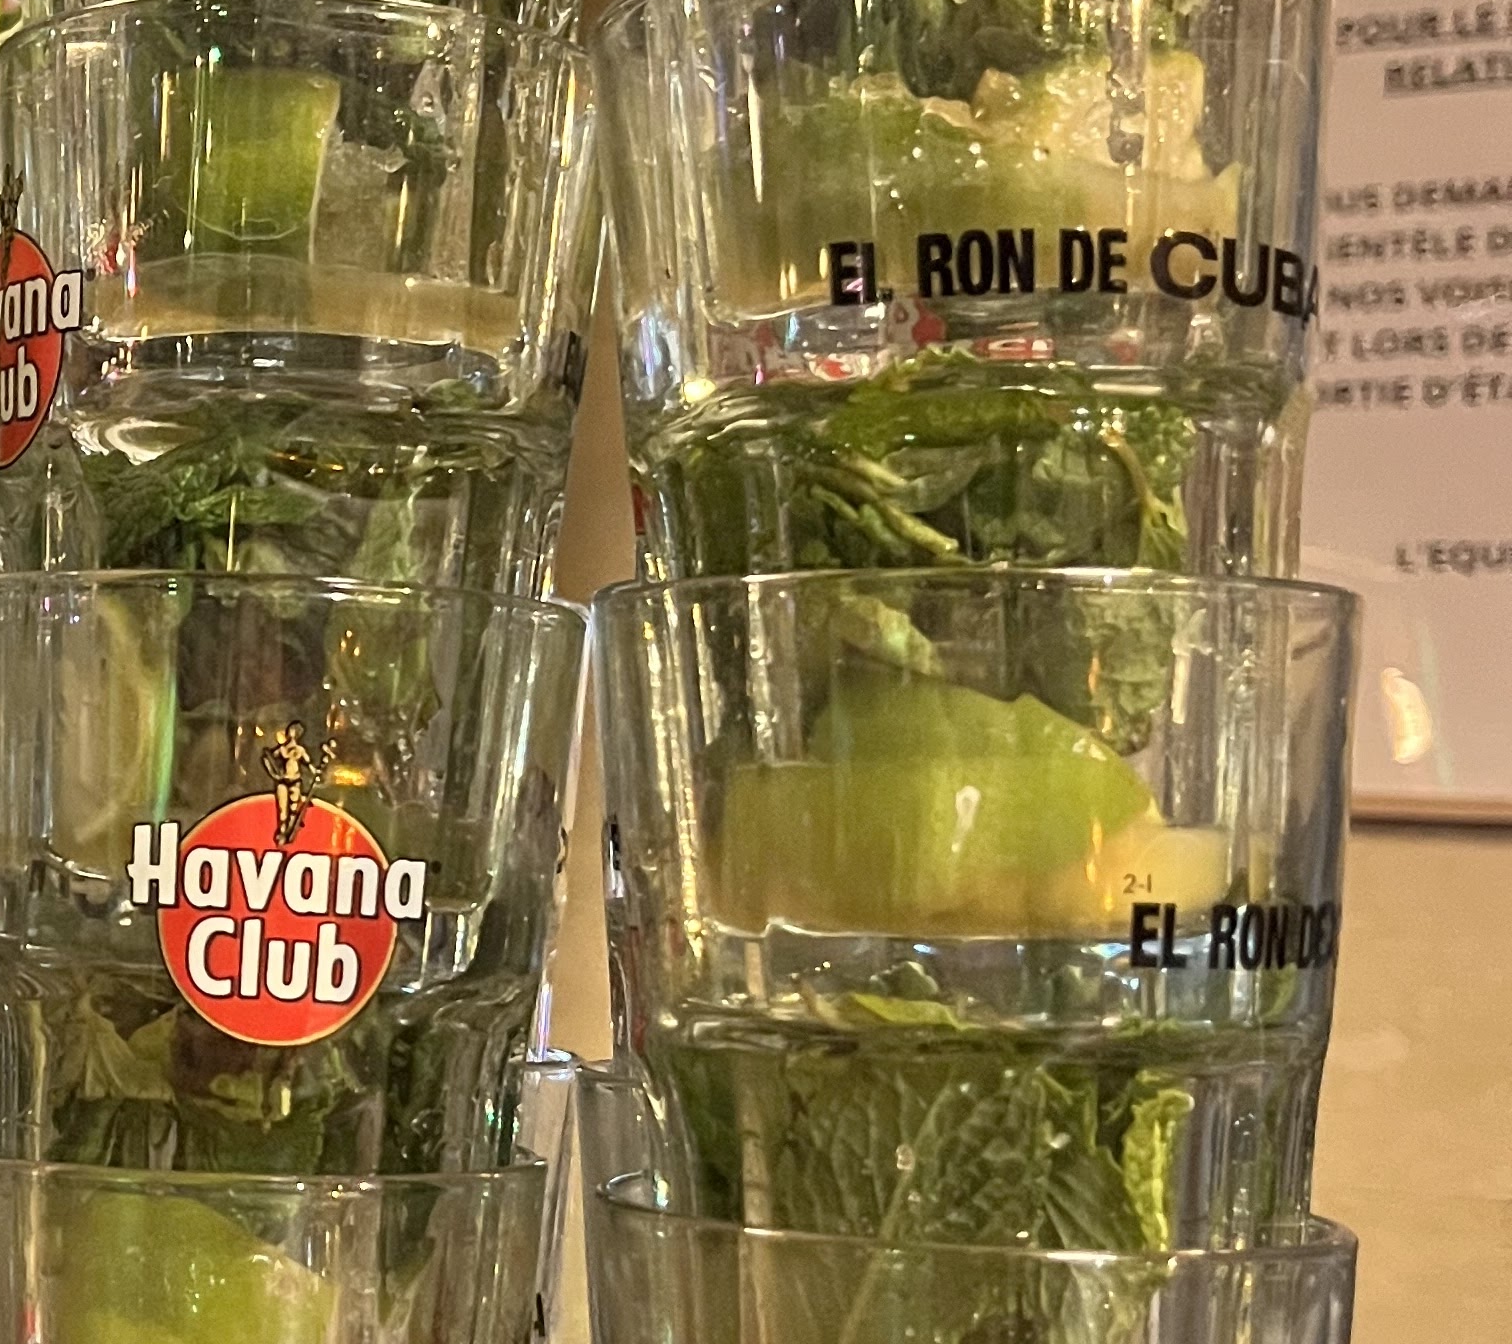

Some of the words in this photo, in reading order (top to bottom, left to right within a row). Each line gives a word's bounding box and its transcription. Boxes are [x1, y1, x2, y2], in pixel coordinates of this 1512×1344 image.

[828, 241, 892, 307] EL
[916, 227, 1036, 298] RON
[1059, 227, 1129, 295] DE
[1150, 231, 1321, 329] CUBA
[126, 820, 428, 921] Havana
[185, 913, 360, 1004] Club
[1130, 902, 1186, 968] EL
[1209, 903, 1289, 969] RON
